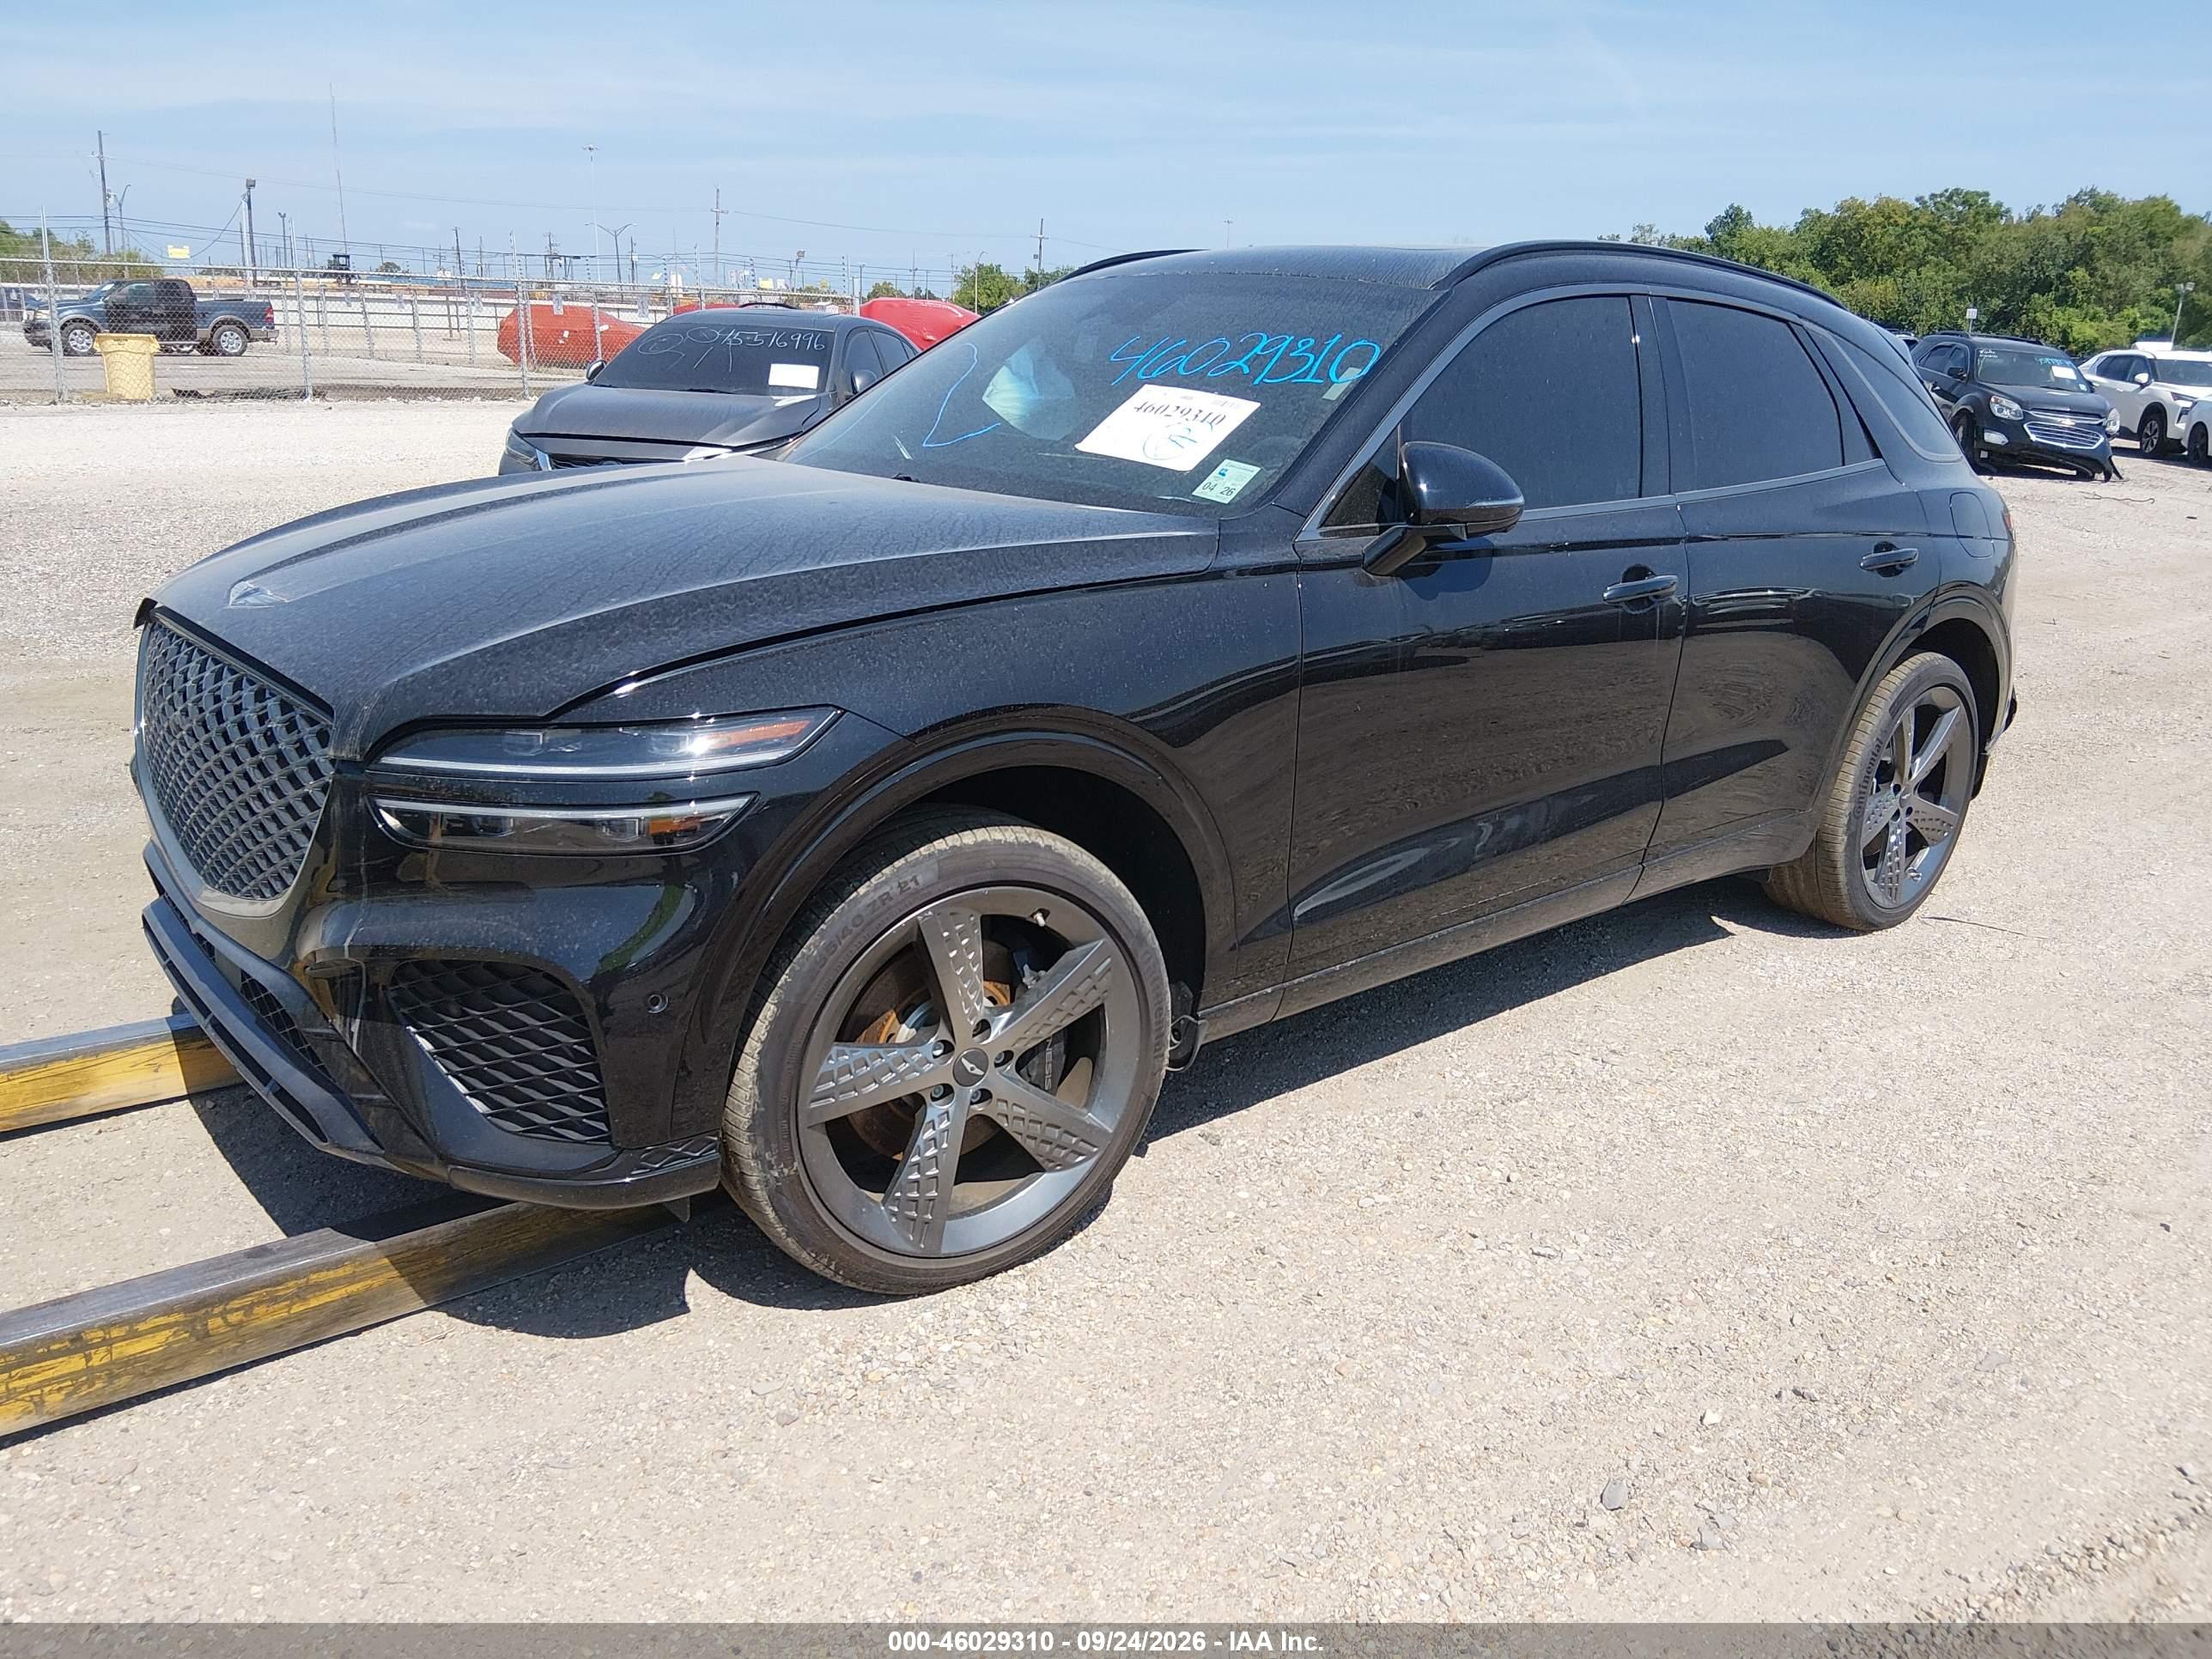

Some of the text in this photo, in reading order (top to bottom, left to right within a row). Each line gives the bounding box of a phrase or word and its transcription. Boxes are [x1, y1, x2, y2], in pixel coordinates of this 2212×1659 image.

[1110, 332, 1382, 386] 46029310
[1133, 400, 1227, 427] 46029310
[1201, 481, 1237, 496] 04 26
[1853, 737, 1884, 819] Continental
